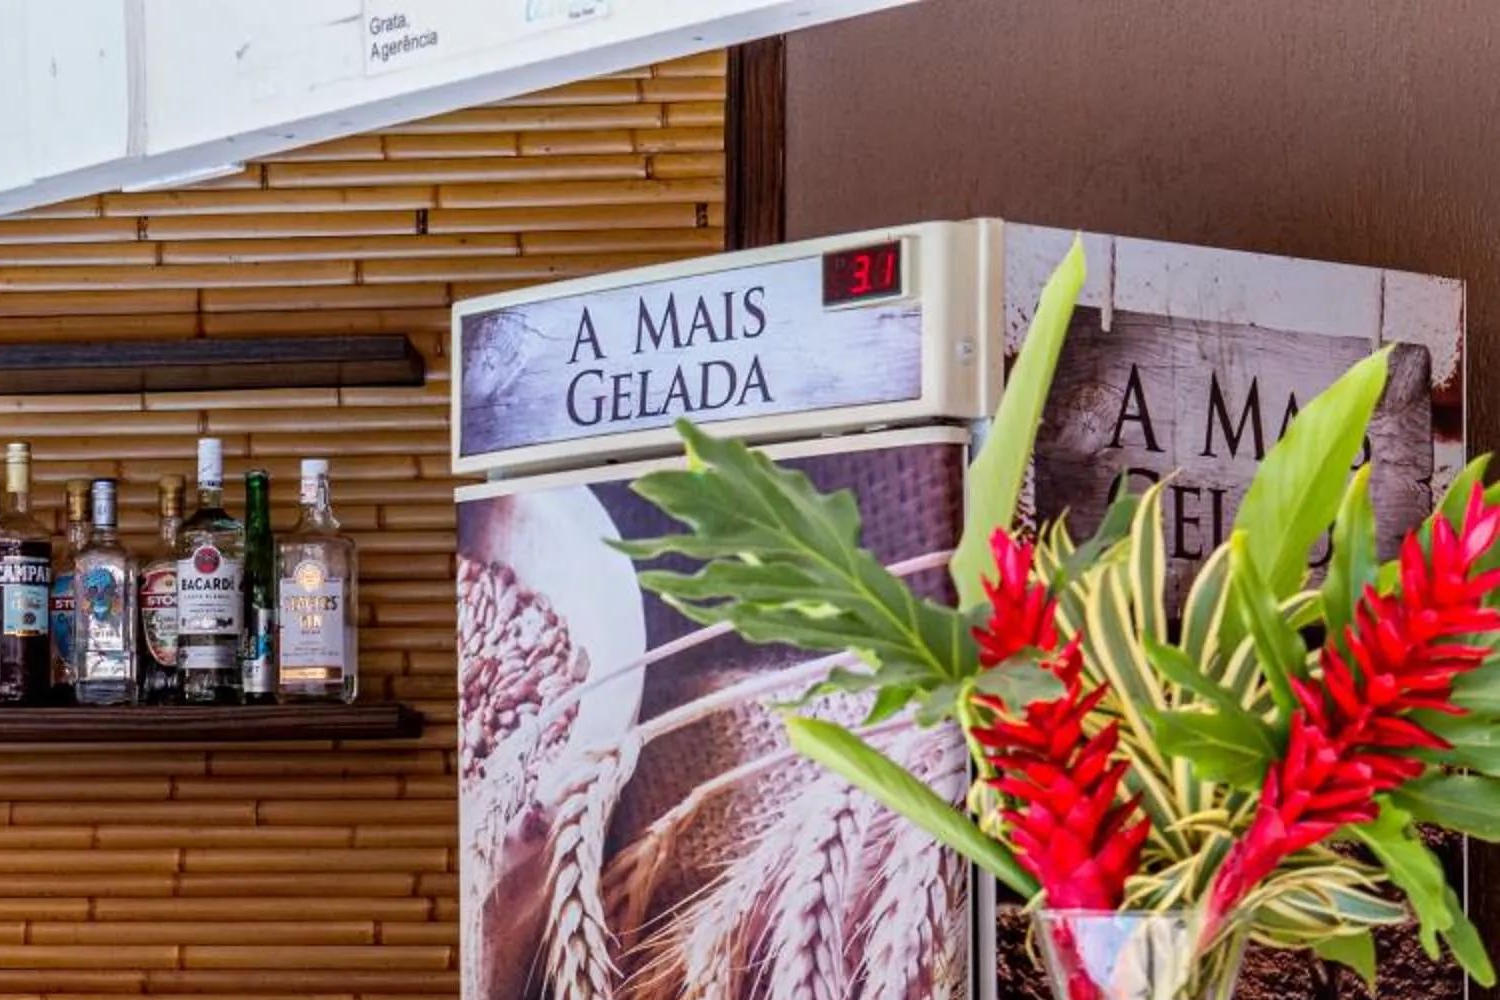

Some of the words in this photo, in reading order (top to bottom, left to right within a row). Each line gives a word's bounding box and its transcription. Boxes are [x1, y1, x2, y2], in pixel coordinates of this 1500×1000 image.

[567, 306, 607, 364] A
[632, 286, 767, 355] MAIS
[566, 353, 775, 427] GELADA
[1104, 363, 1166, 452] A
